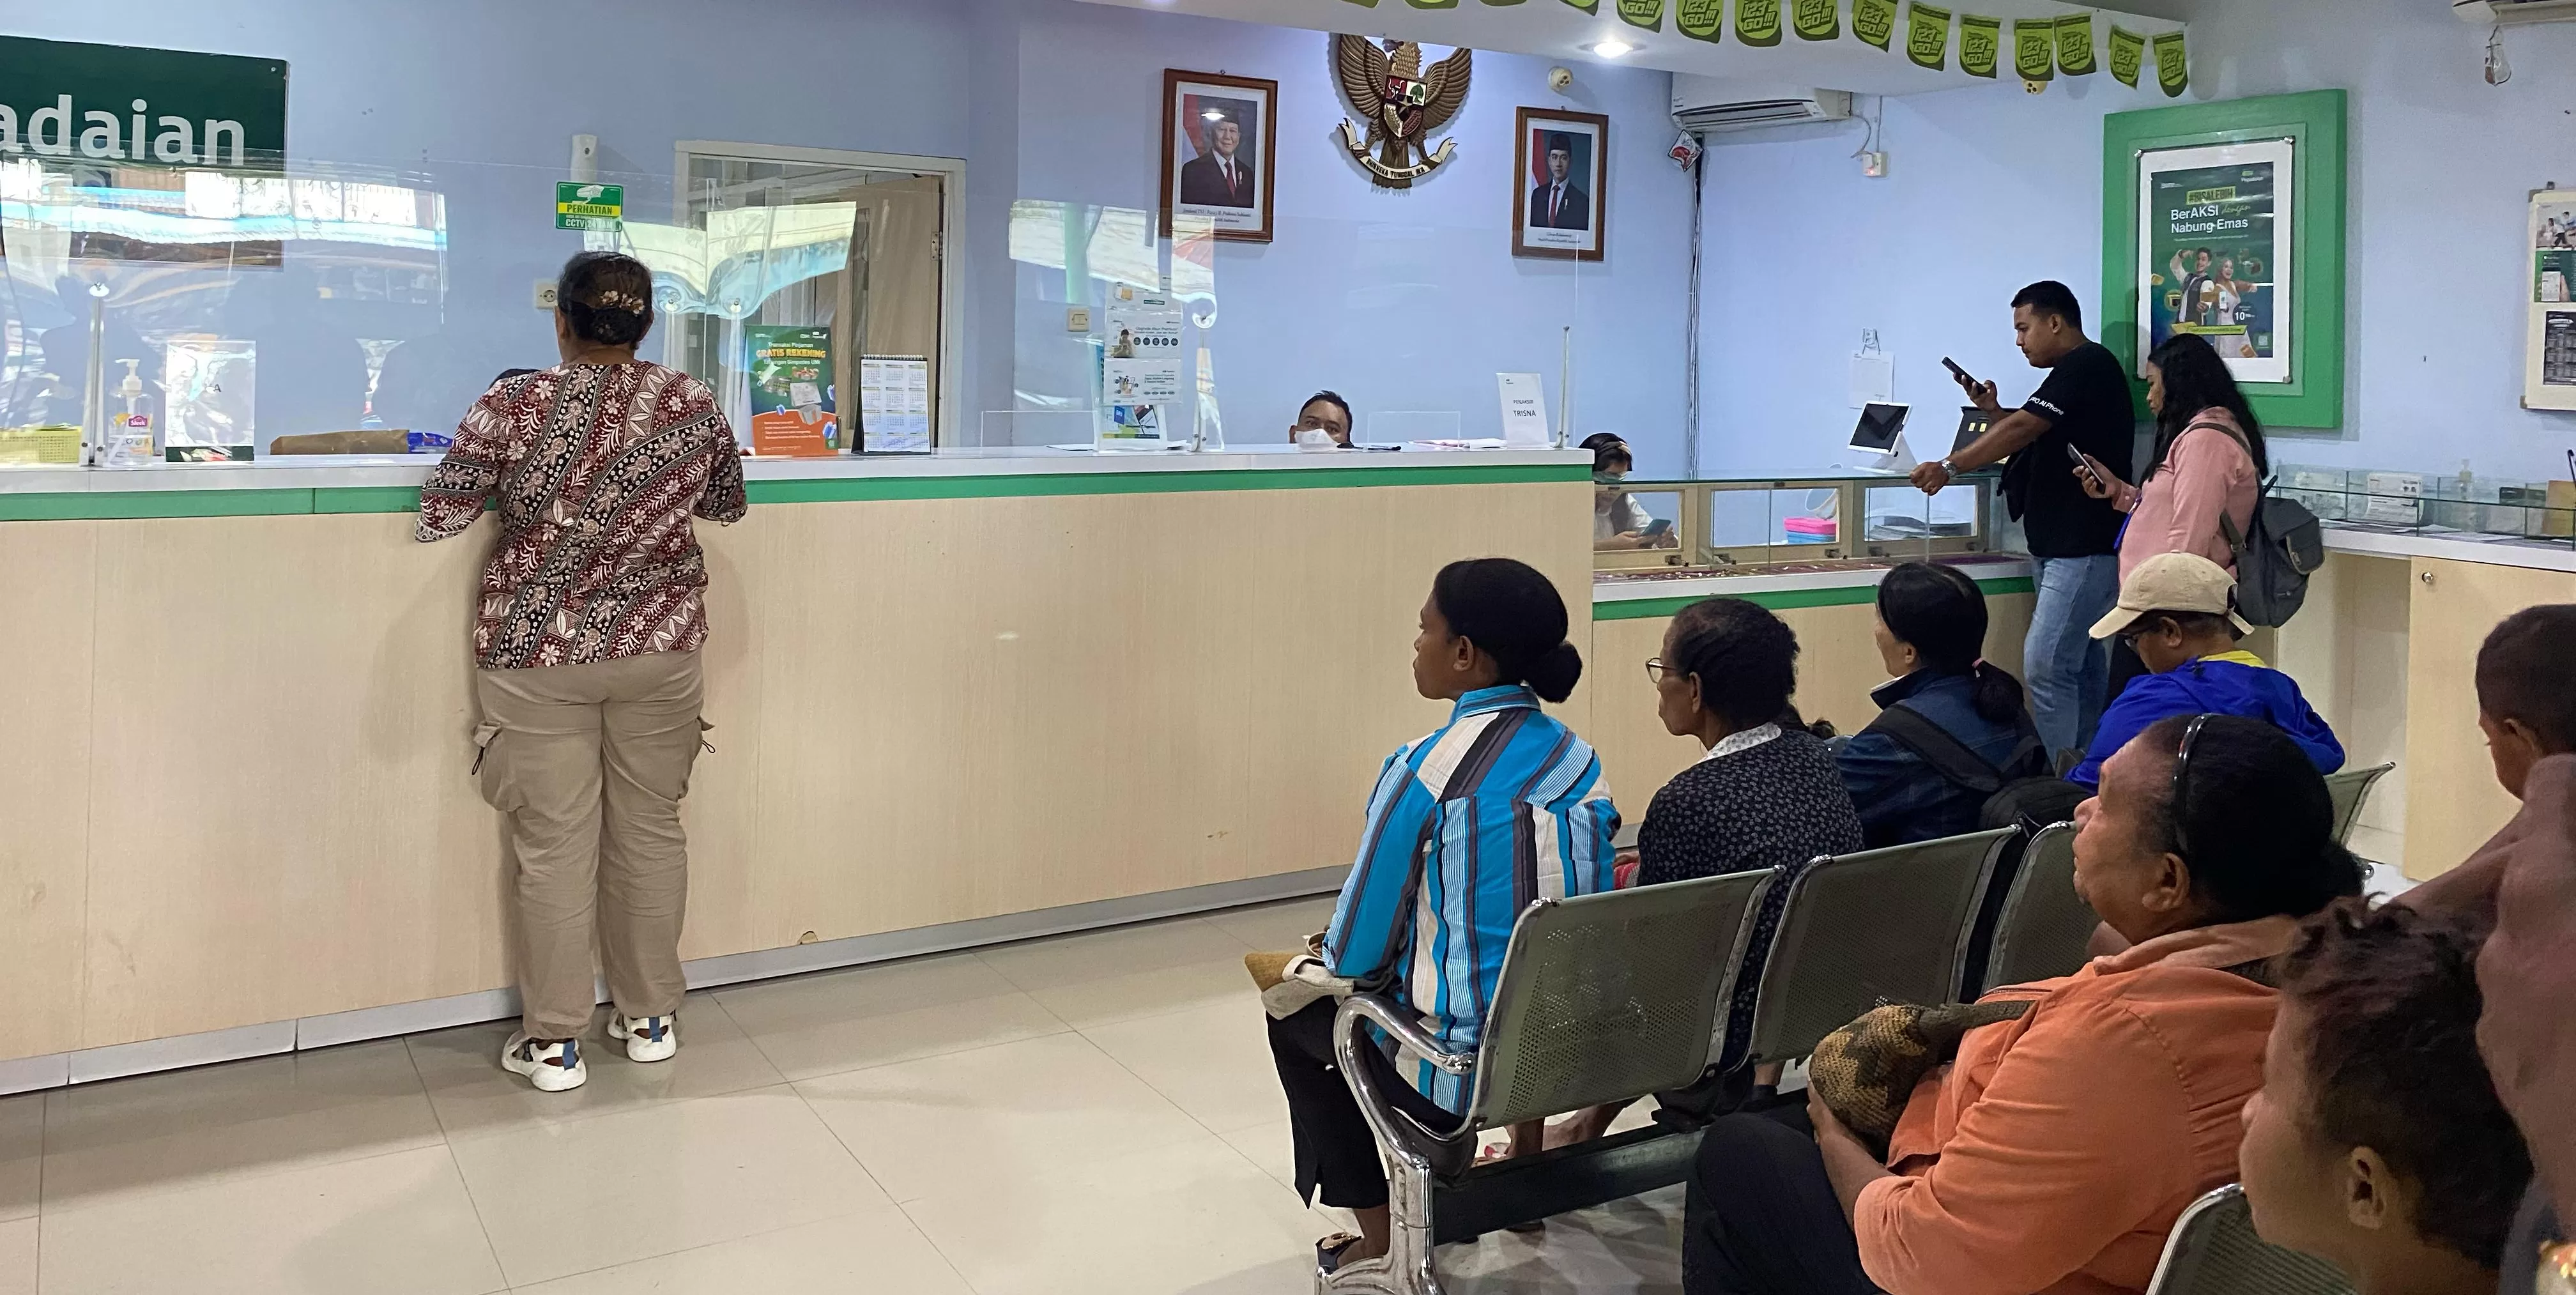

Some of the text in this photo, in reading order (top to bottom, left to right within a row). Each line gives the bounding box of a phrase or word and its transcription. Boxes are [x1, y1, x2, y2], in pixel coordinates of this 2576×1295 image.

[1683, 0, 1708, 13] 123
[1742, 3, 1767, 17] 123
[1800, 1, 1823, 17] 123
[1685, 10, 1718, 26] GO!!!
[1744, 11, 1776, 30] GO!!!
[1802, 6, 1833, 28] GO!!!
[1859, 7, 1883, 24] 123
[1859, 22, 1889, 36] GO!!!
[1914, 27, 1936, 43] 123
[1915, 41, 1943, 54] GO!!!
[1966, 39, 1988, 53] 123
[2022, 41, 2041, 56] 123
[2062, 37, 2081, 53] 123
[567, 204, 612, 215] PERHATIAN
[2171, 204, 2219, 220] BerAKSI
[565, 218, 585, 227] CCTV
[2172, 218, 2248, 233] Nabung Emas
[2235, 312, 2245, 320] 10
[756, 349, 826, 358] GRATIS REKENING
[2045, 402, 2064, 415] Phone
